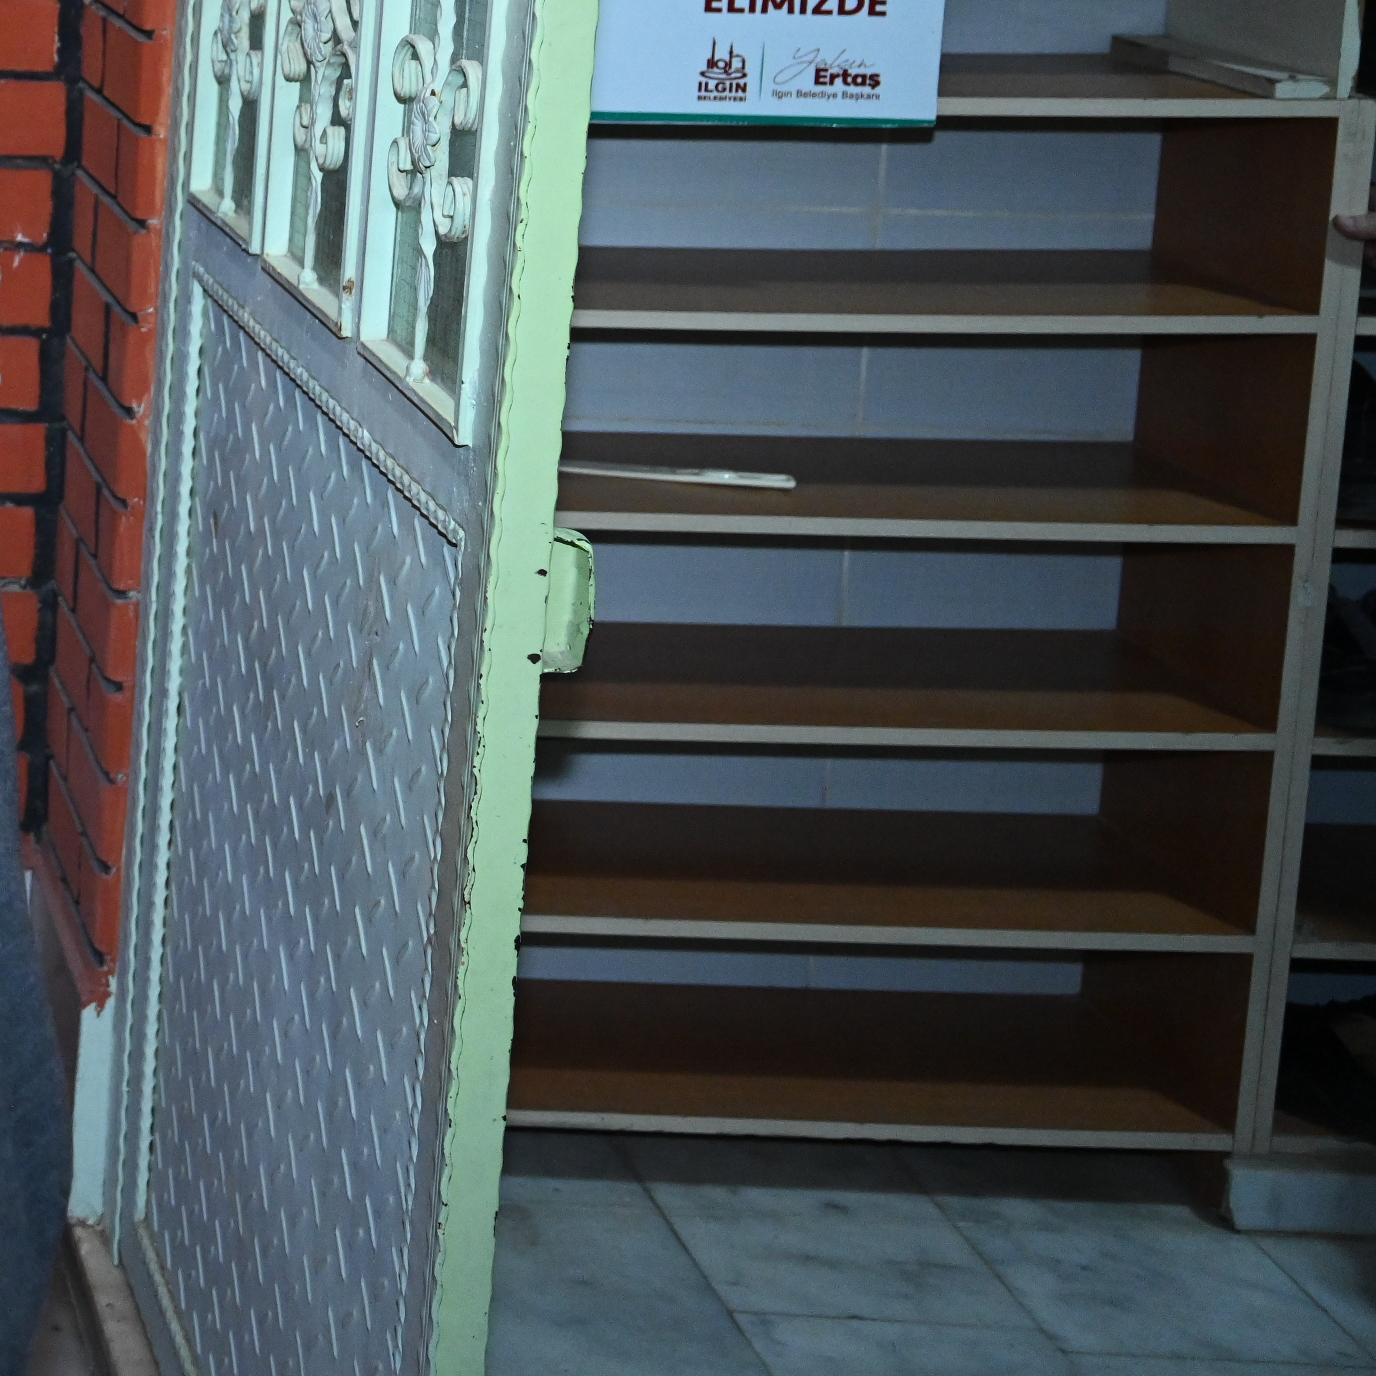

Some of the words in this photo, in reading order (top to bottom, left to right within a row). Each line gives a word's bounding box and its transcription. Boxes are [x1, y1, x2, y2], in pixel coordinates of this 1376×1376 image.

[814, 68, 881, 89] Ertaş
[697, 80, 748, 94] ILGIN
[796, 90, 838, 100] Belediye
